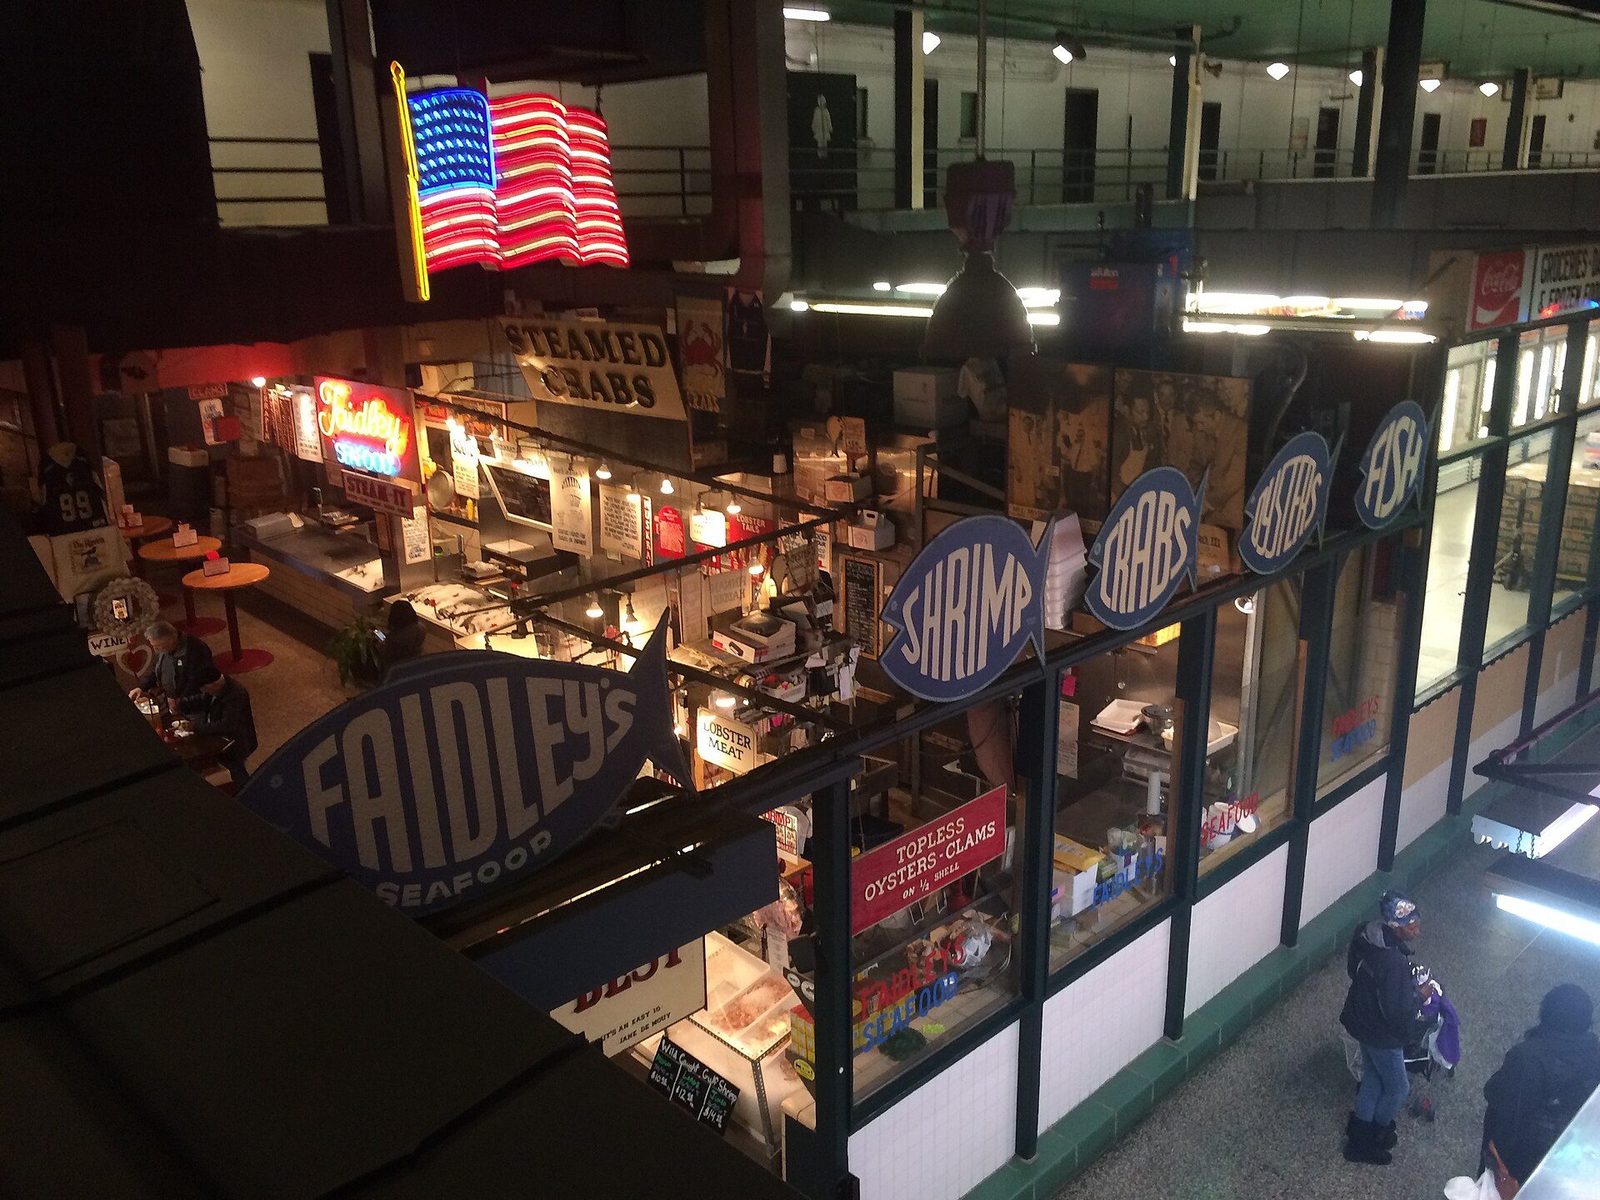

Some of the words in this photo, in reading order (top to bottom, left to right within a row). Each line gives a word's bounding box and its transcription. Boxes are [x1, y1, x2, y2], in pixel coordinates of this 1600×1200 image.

[505, 324, 664, 367] STEAMED
[541, 365, 655, 408] CRABS
[1364, 416, 1422, 518] FISH
[736, 514, 766, 528] LOBSTER
[1251, 454, 1322, 559] OYSTERS
[742, 523, 760, 534] TAILS
[1100, 490, 1192, 614] CRABS
[901, 543, 1033, 682] SHRIMP
[703, 721, 752, 751] LOBSTER
[708, 736, 744, 761] MEAT
[302, 676, 637, 873] FAIDLEY'S
[896, 817, 965, 864] TOPLESS
[902, 886, 915, 900] ON
[934, 861, 960, 882] SHELL
[618, 1022, 629, 1033] AN
[632, 1012, 650, 1026] EASY
[861, 971, 959, 1053] SEAFOOD
